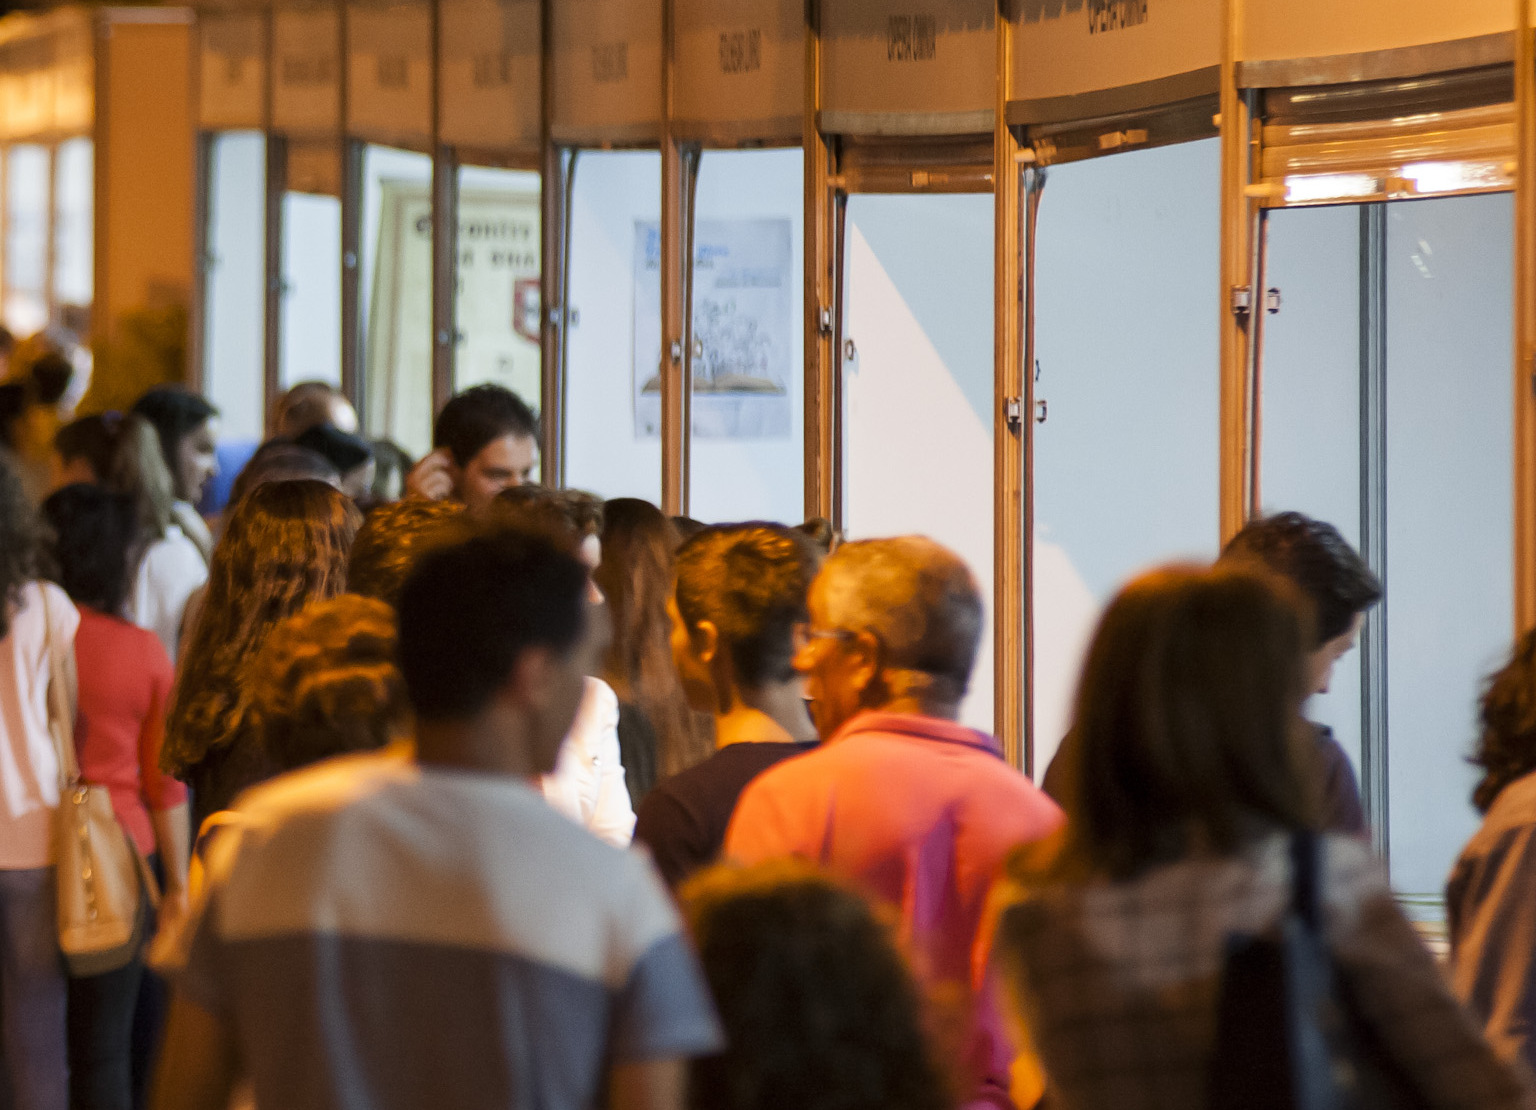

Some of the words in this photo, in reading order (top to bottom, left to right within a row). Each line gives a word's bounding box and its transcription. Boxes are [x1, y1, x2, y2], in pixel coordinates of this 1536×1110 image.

[887, 13, 911, 63] OPERA
[912, 13, 937, 61] OMNIA
[1088, 0, 1116, 35] OPERA
